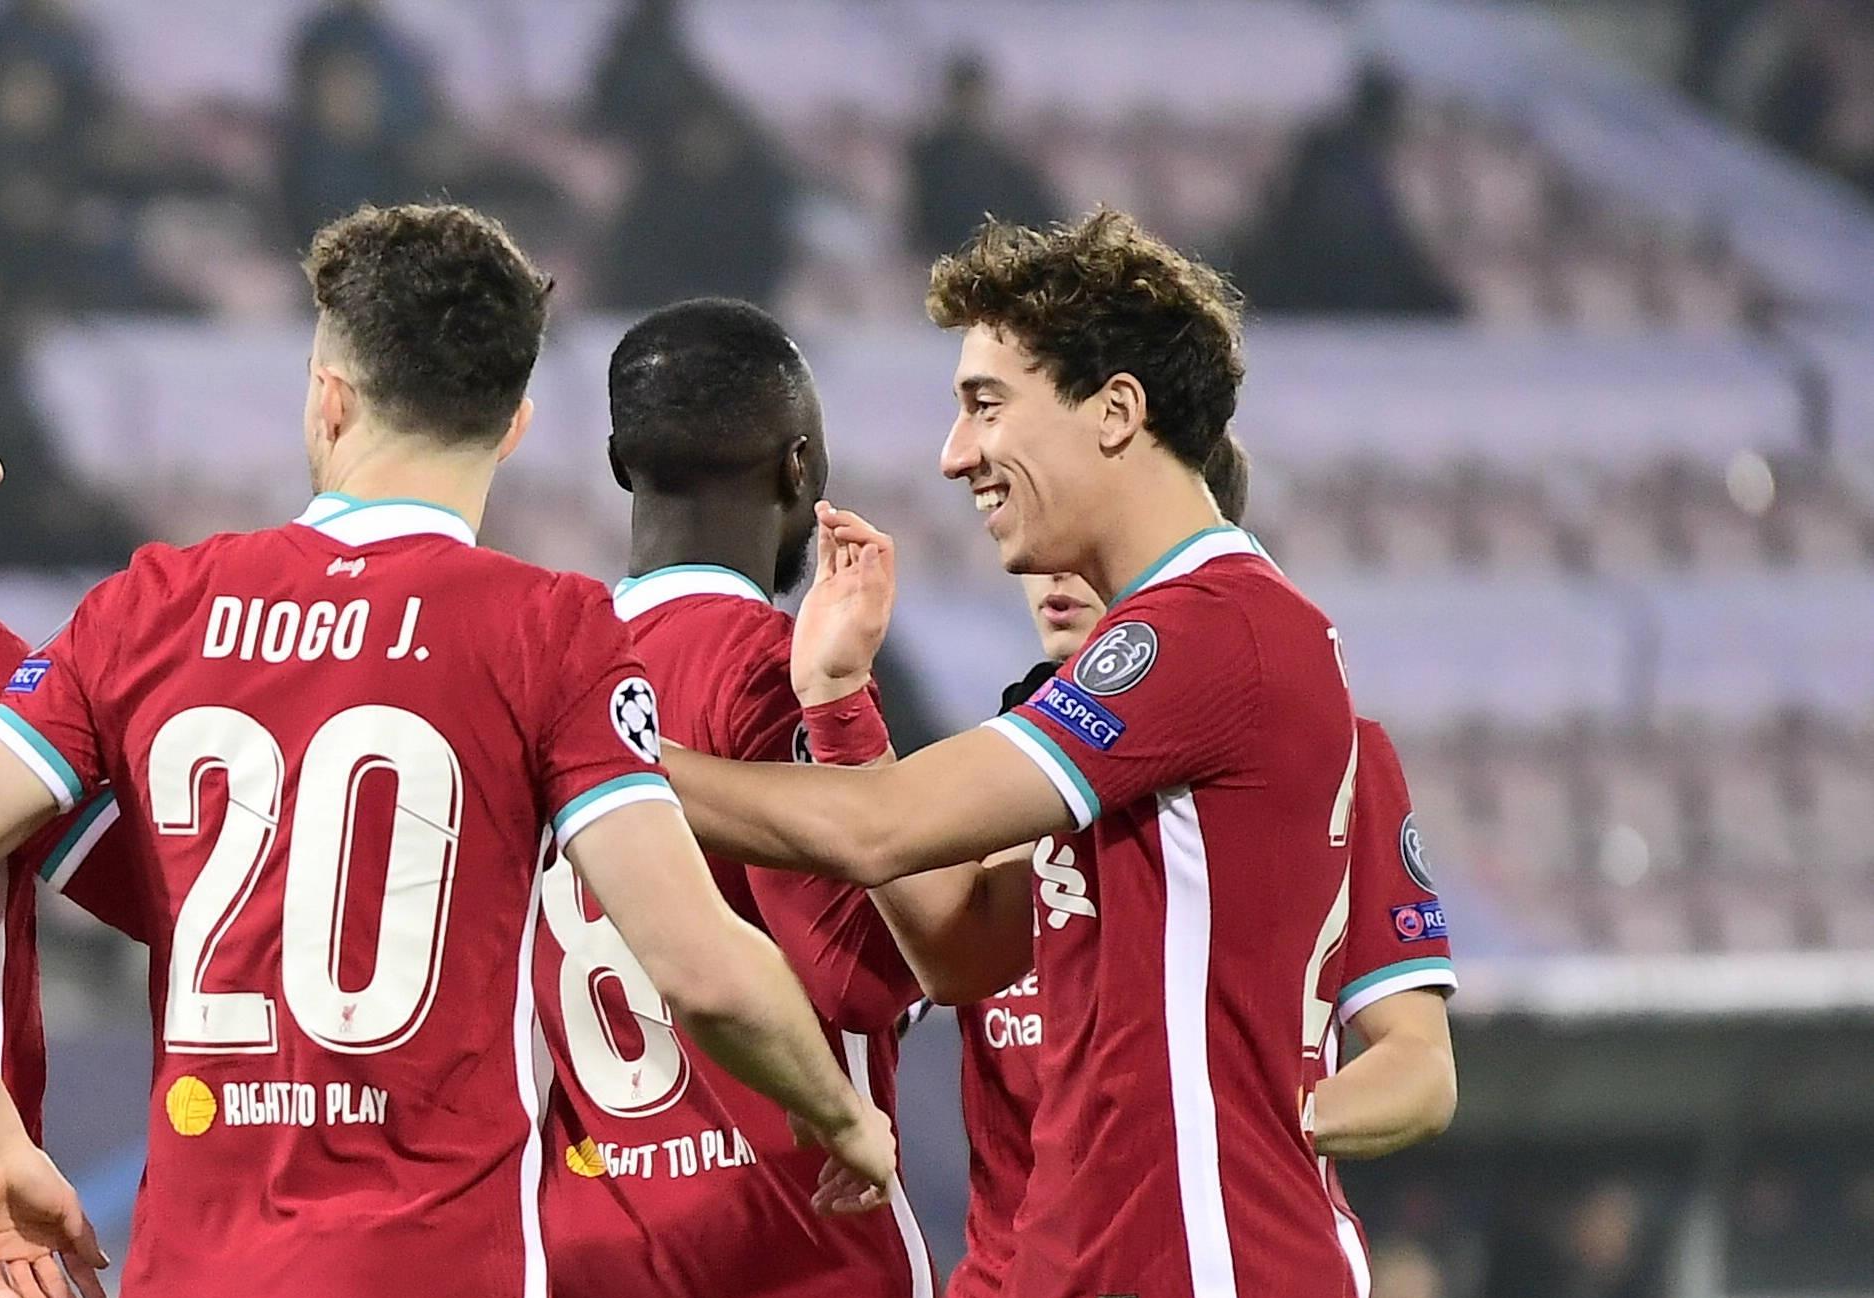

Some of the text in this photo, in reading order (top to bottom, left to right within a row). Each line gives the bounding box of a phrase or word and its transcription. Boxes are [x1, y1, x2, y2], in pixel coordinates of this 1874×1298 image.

[202, 595, 430, 663] DIOGO J.
[1096, 654, 1117, 674] 6
[1044, 687, 1119, 744] RESPECT
[147, 704, 464, 1055] 20
[325, 1082, 389, 1126] PLAY
[661, 1136, 698, 1179] TO
